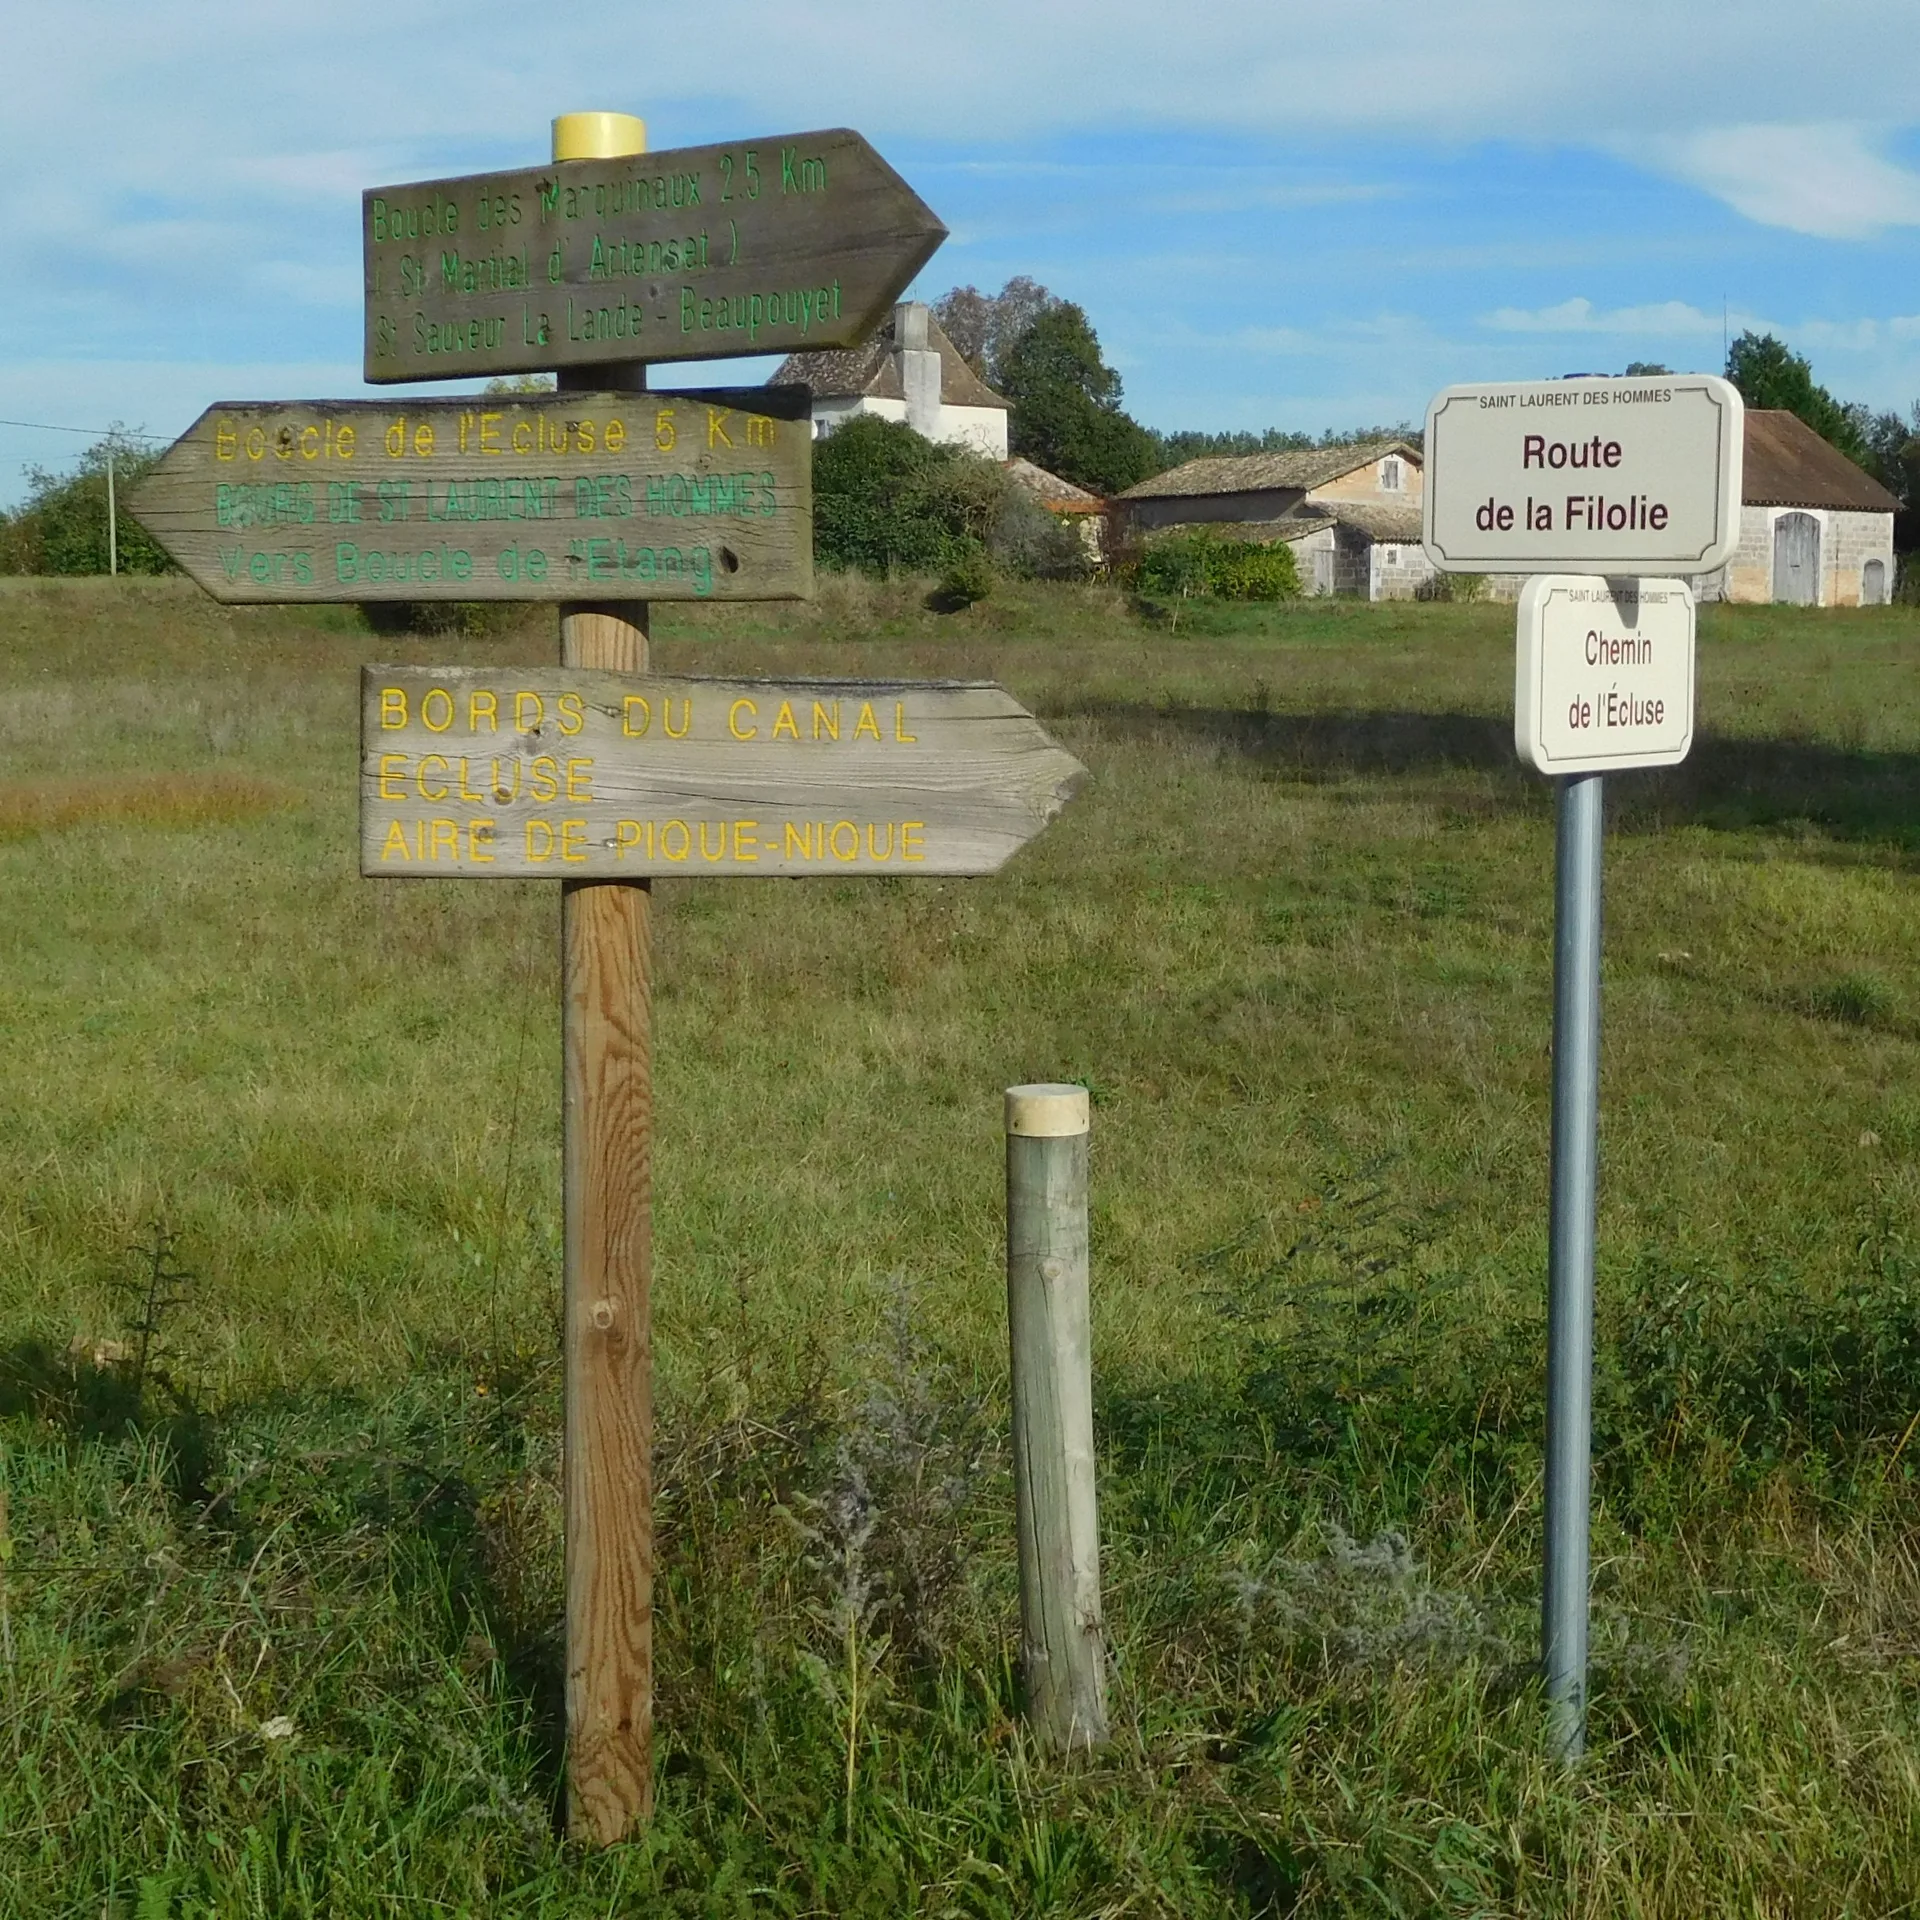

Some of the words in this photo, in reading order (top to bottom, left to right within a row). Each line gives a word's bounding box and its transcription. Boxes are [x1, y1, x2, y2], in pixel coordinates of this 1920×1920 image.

[374, 192, 459, 243] Boucle
[478, 185, 523, 231] des
[536, 166, 701, 229] Marquinaux
[719, 152, 761, 203] 2.5
[781, 147, 827, 195] Km
[401, 253, 424, 299] St
[442, 242, 530, 295] Martial
[589, 227, 709, 279] Artenset
[412, 311, 506, 355] Sauveur
[523, 301, 553, 347] La
[568, 294, 643, 342] Lande
[681, 278, 842, 342] Beaupouyet
[1479, 395, 1517, 409] SAINT
[1520, 392, 1580, 408] LAURENT
[1583, 391, 1609, 406] DES
[1613, 388, 1672, 405] HOMMES
[385, 416, 435, 459] de
[458, 410, 627, 456] l'Ecluse
[655, 409, 677, 452] 5
[1523, 434, 1622, 469] Route
[328, 480, 363, 525] DE
[376, 478, 411, 524] ST
[427, 475, 560, 523] LAURENT
[576, 474, 632, 520] DES
[645, 471, 777, 519] HOMMES
[1476, 497, 1515, 531] de
[1526, 496, 1553, 531] la
[1566, 495, 1669, 531] Filolie
[216, 543, 315, 585] Vers
[335, 540, 473, 584] Boucle
[498, 538, 549, 584] de
[567, 537, 714, 597] l'Etang
[1569, 589, 1590, 603] SAINT
[1591, 589, 1624, 603] LAURENT
[1625, 590, 1638, 604] DES
[1640, 592, 1668, 604] HOMMES
[1585, 630, 1652, 666] Chemin
[380, 687, 586, 736] BORDS
[622, 695, 692, 739] DU
[728, 698, 918, 743] CANAL
[1569, 693, 1591, 729] de
[1597, 682, 1665, 728] l'Écluse
[378, 753, 595, 803] ECLUSE
[380, 818, 496, 863] AIRE
[524, 819, 588, 863] DE
[616, 818, 926, 863] PIQUE-NIQUE
